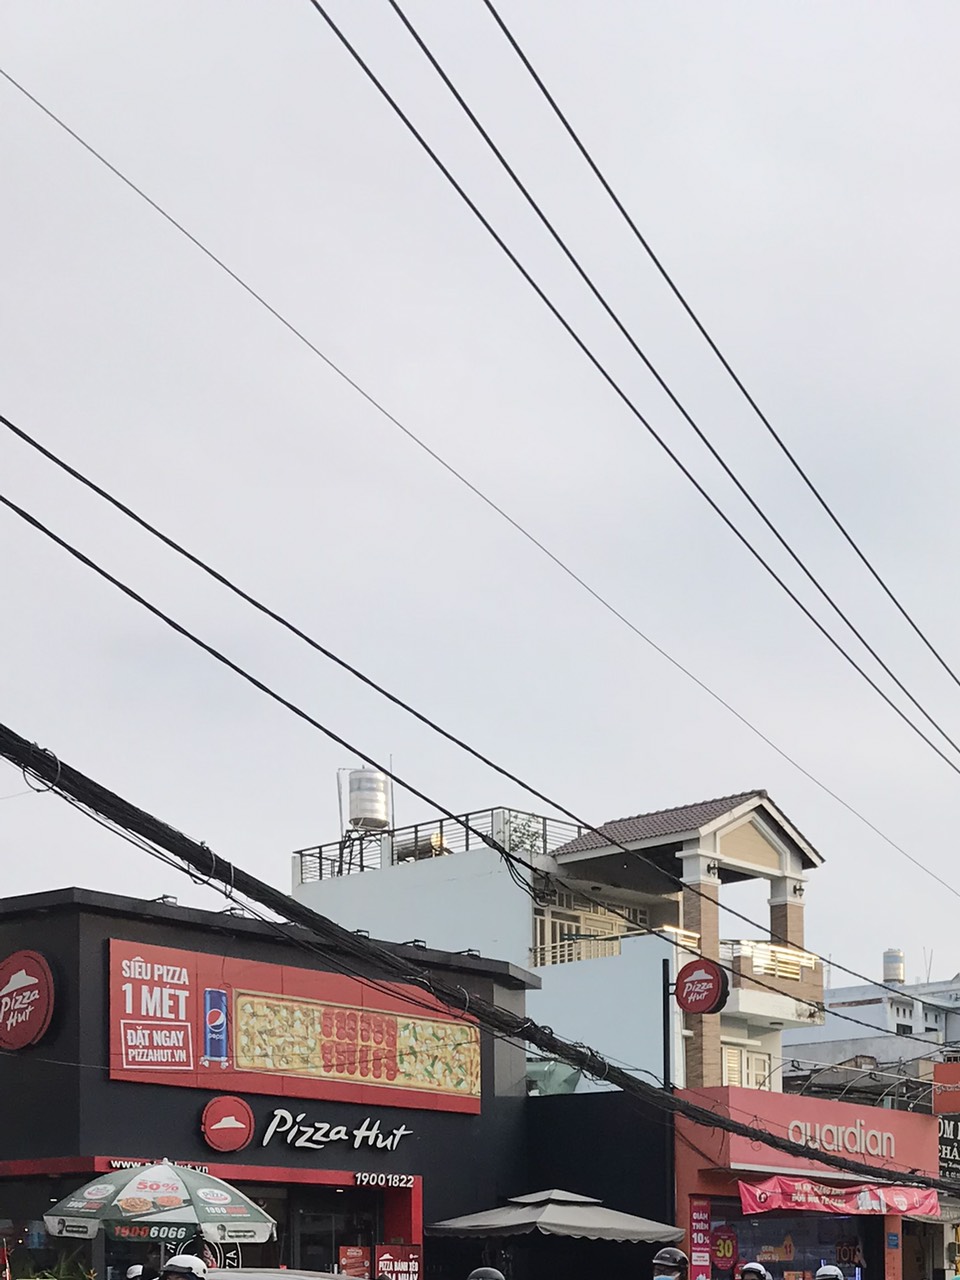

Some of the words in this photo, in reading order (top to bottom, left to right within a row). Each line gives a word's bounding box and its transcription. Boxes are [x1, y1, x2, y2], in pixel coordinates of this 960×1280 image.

[121, 956, 151, 980] SIÊU
[153, 964, 189, 985] PIZZA
[682, 981, 713, 998] Pizza
[688, 991, 709, 1004] Hut
[0, 990, 40, 1023] Pizza
[122, 983, 133, 1014] 1
[141, 985, 190, 1021] MÉT
[6, 1005, 35, 1032] Hut
[127, 1026, 150, 1049] ĐẶT
[153, 1028, 184, 1047] NGAY
[128, 1048, 187, 1062] PIZZAHUT.VN
[262, 1108, 349, 1149] Pizza
[353, 1117, 414, 1150] Hut
[788, 1119, 896, 1159] guardian
[136, 1181, 180, 1192] 50%
[355, 1172, 415, 1188] 19001822
[114, 1224, 187, 1240] 19006066
[692, 1232, 710, 1244] 10%
